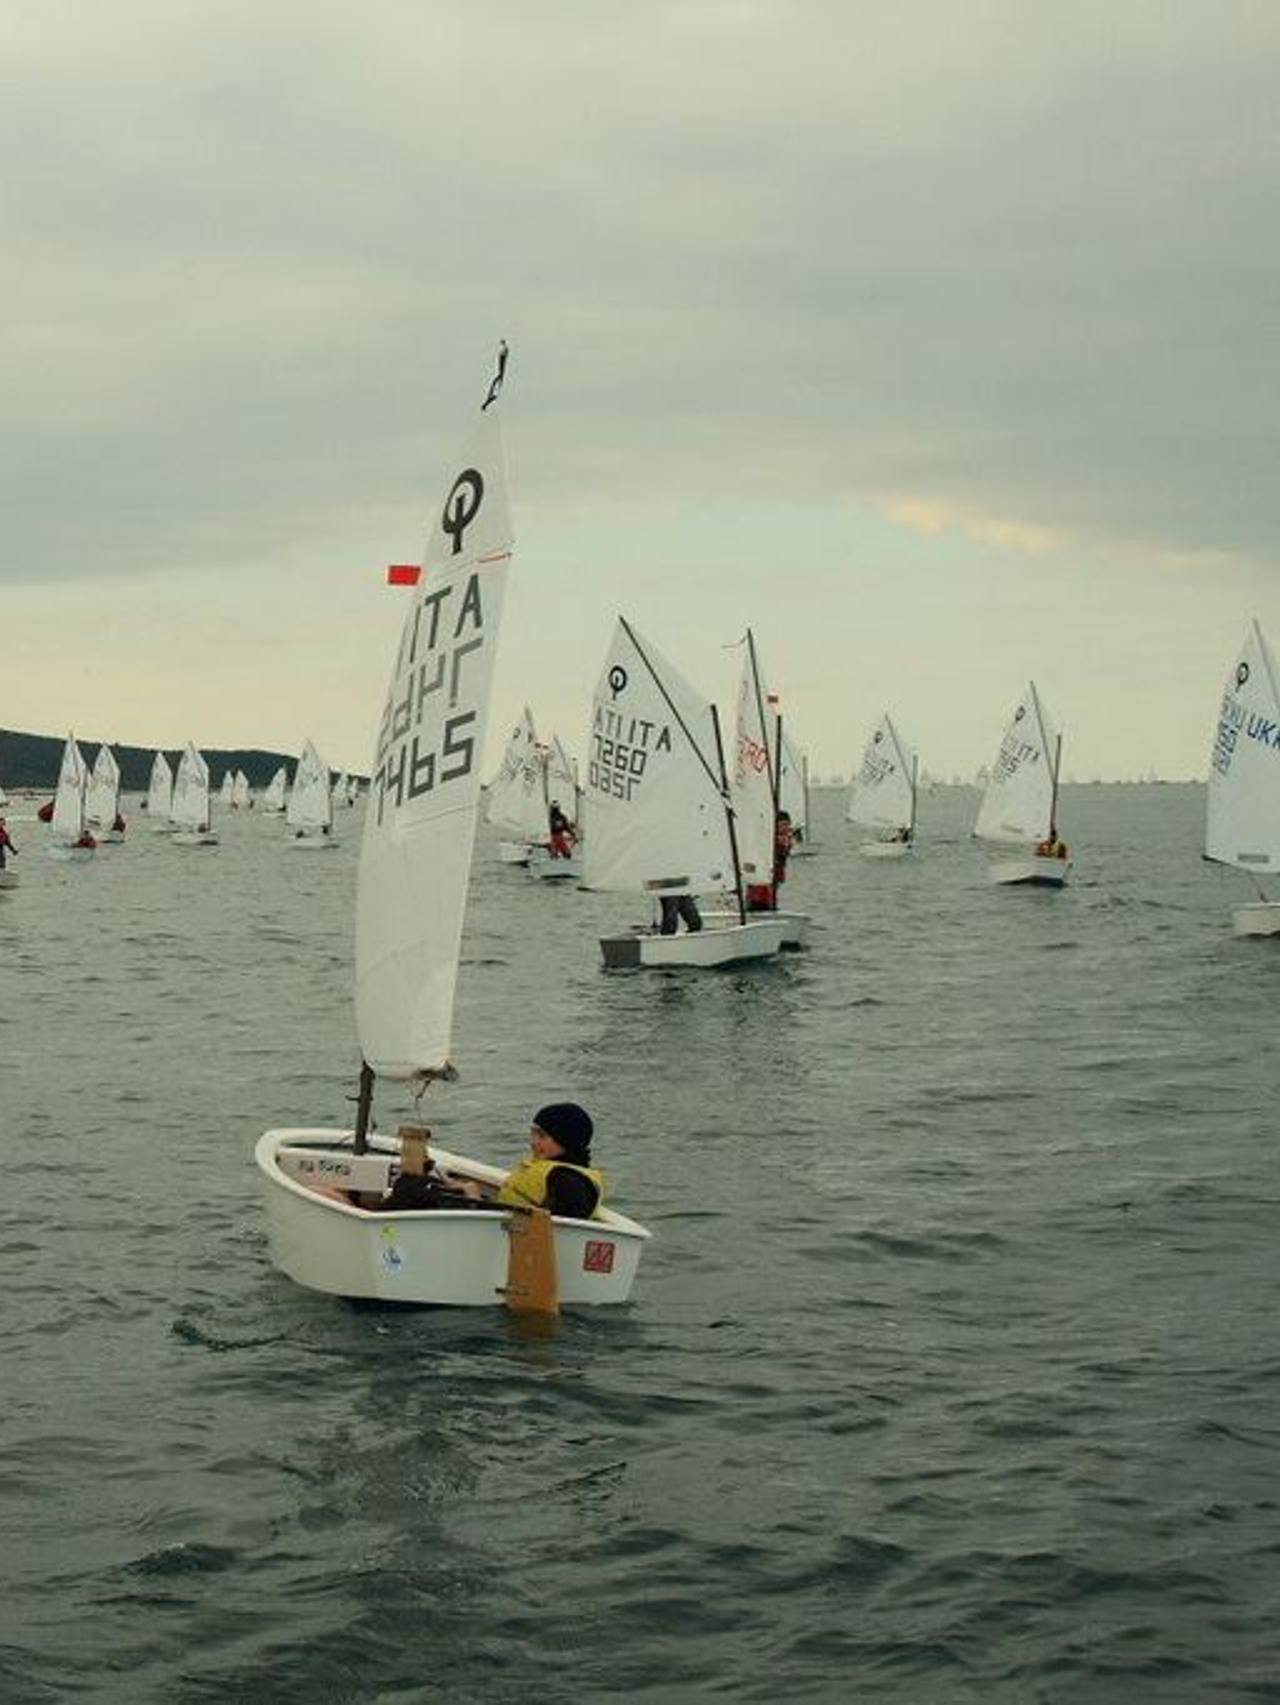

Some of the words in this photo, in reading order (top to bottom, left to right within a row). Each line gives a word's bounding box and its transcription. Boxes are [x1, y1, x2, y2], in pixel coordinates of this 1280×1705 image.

[410, 573, 483, 663] ITA
[594, 734, 646, 775] 7260
[629, 718, 671, 752] ITA
[373, 710, 477, 827] 7465
